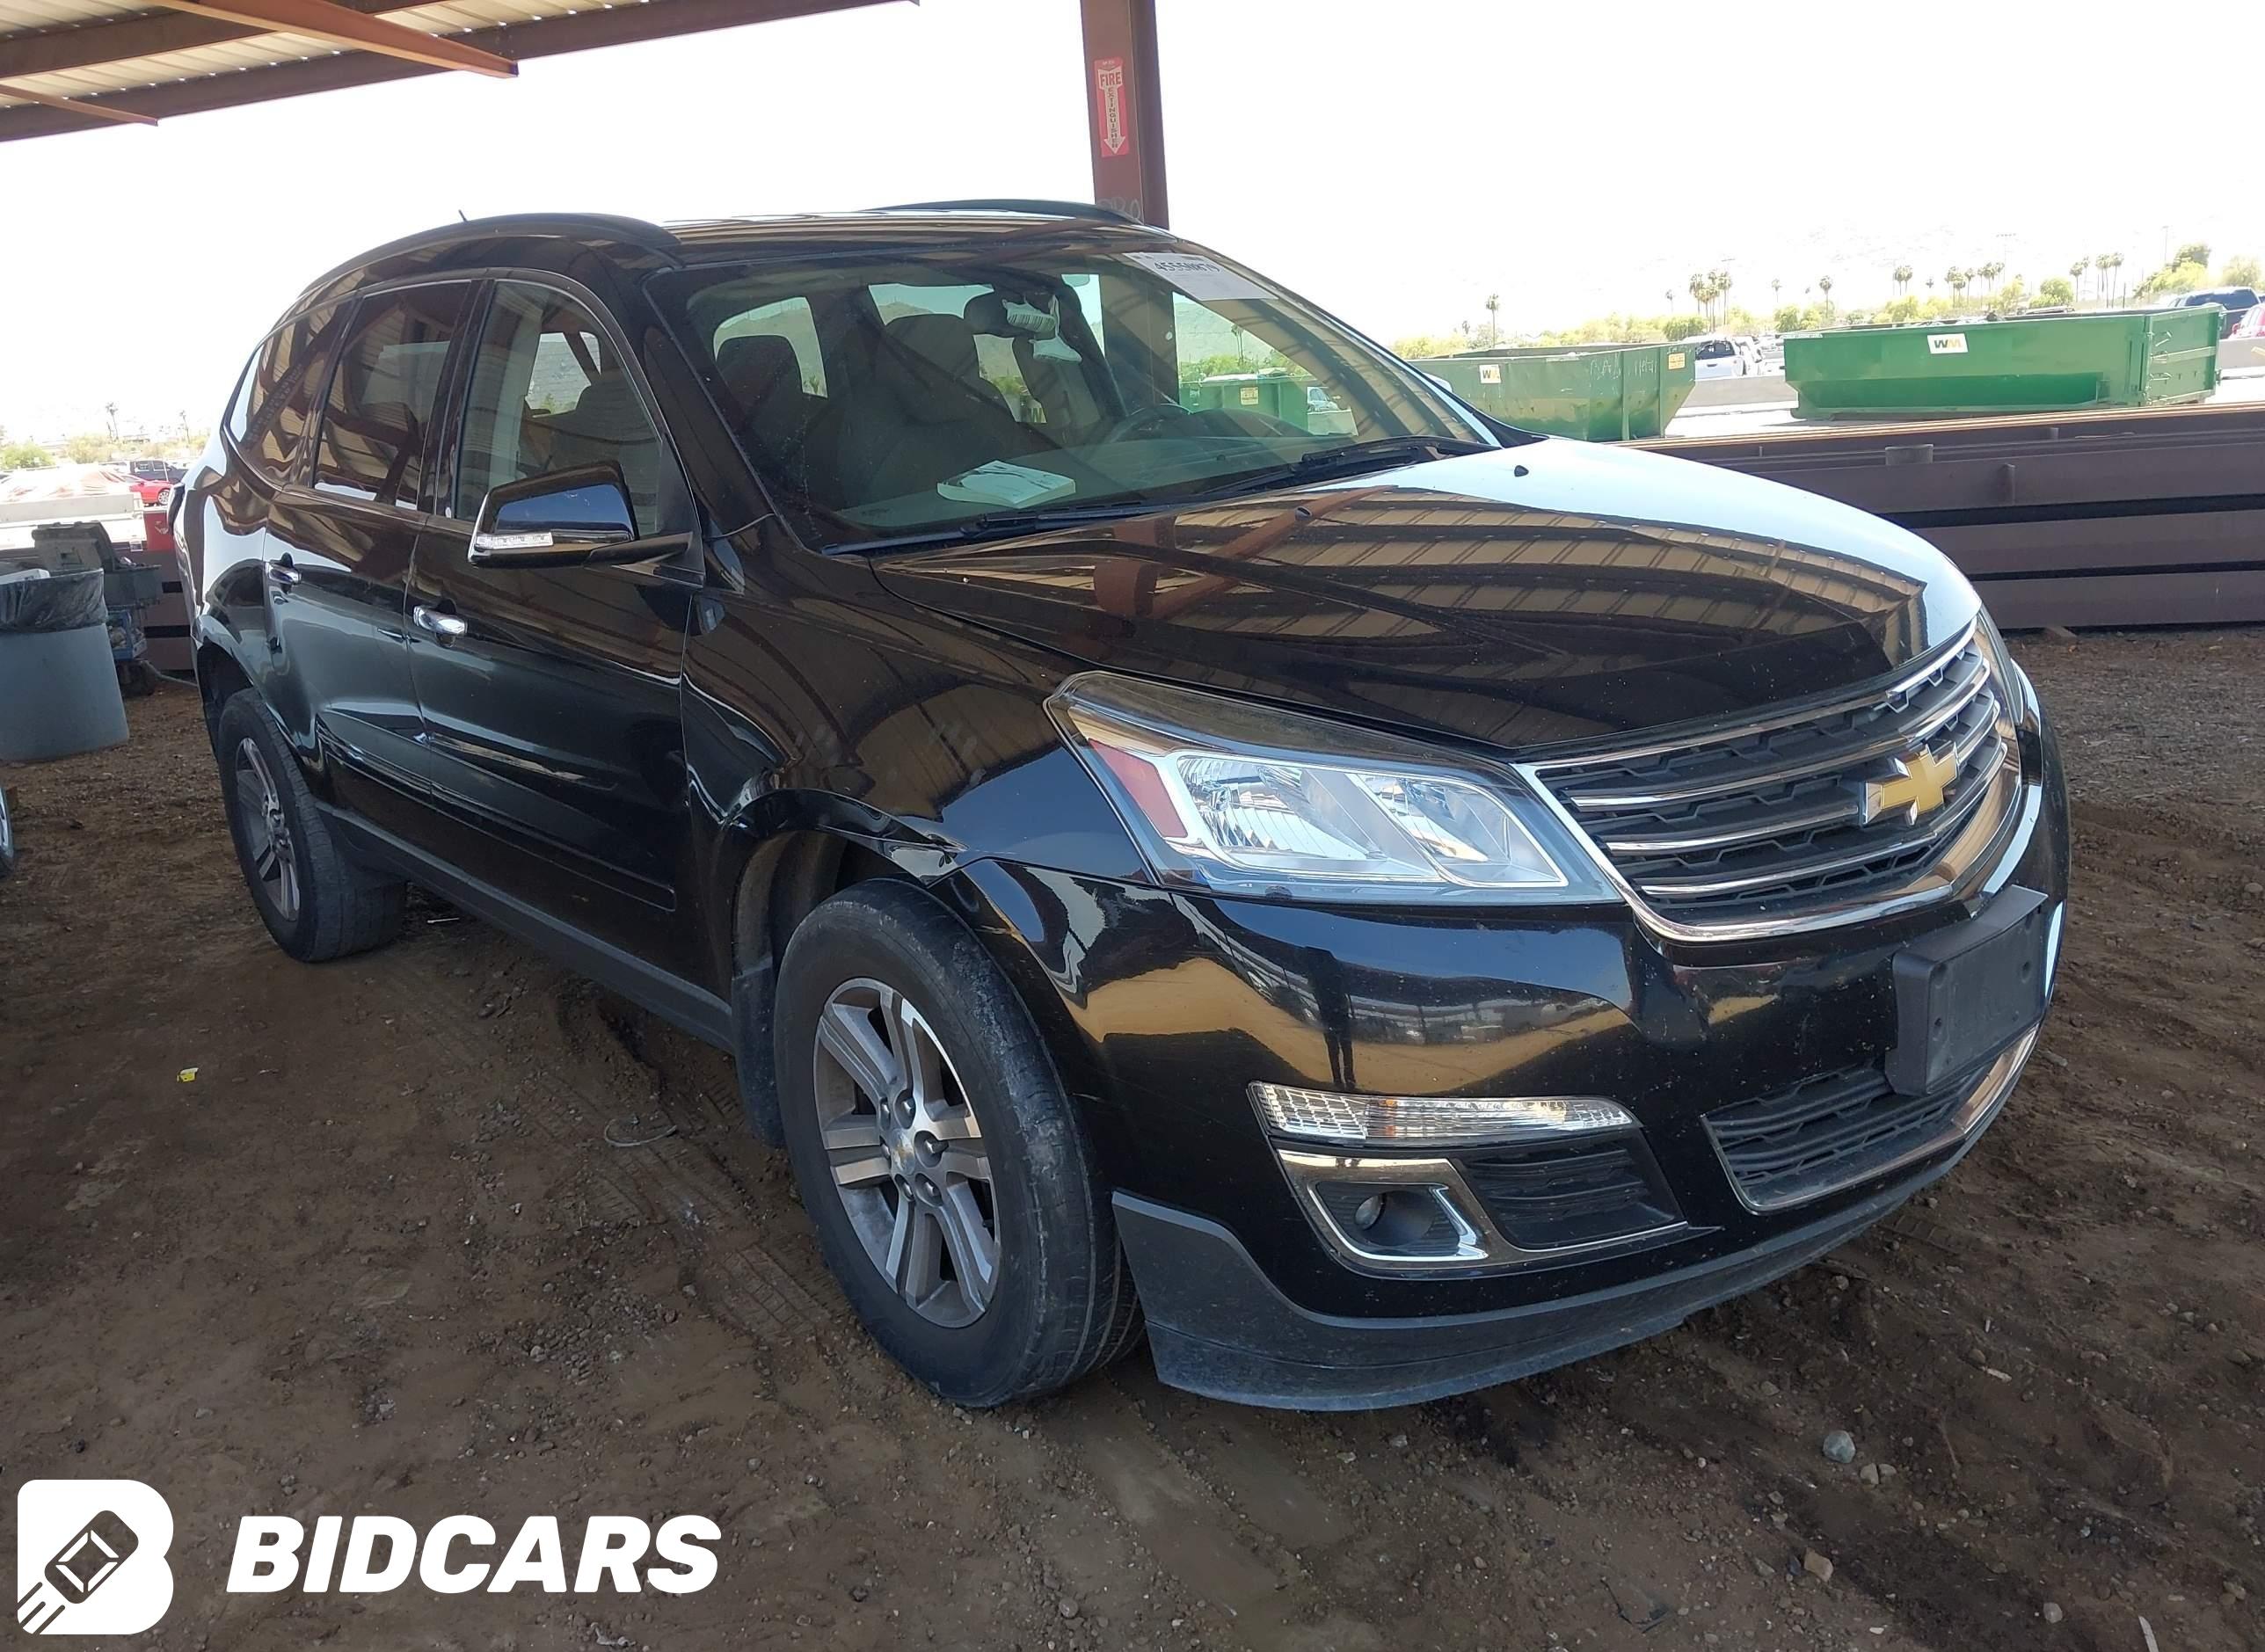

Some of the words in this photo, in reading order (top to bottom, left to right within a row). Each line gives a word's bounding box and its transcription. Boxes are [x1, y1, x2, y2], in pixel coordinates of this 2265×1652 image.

[1099, 71, 1122, 87] FIRE
[1108, 87, 1118, 149] EXTINGUISHER
[1934, 338, 1962, 349] WM
